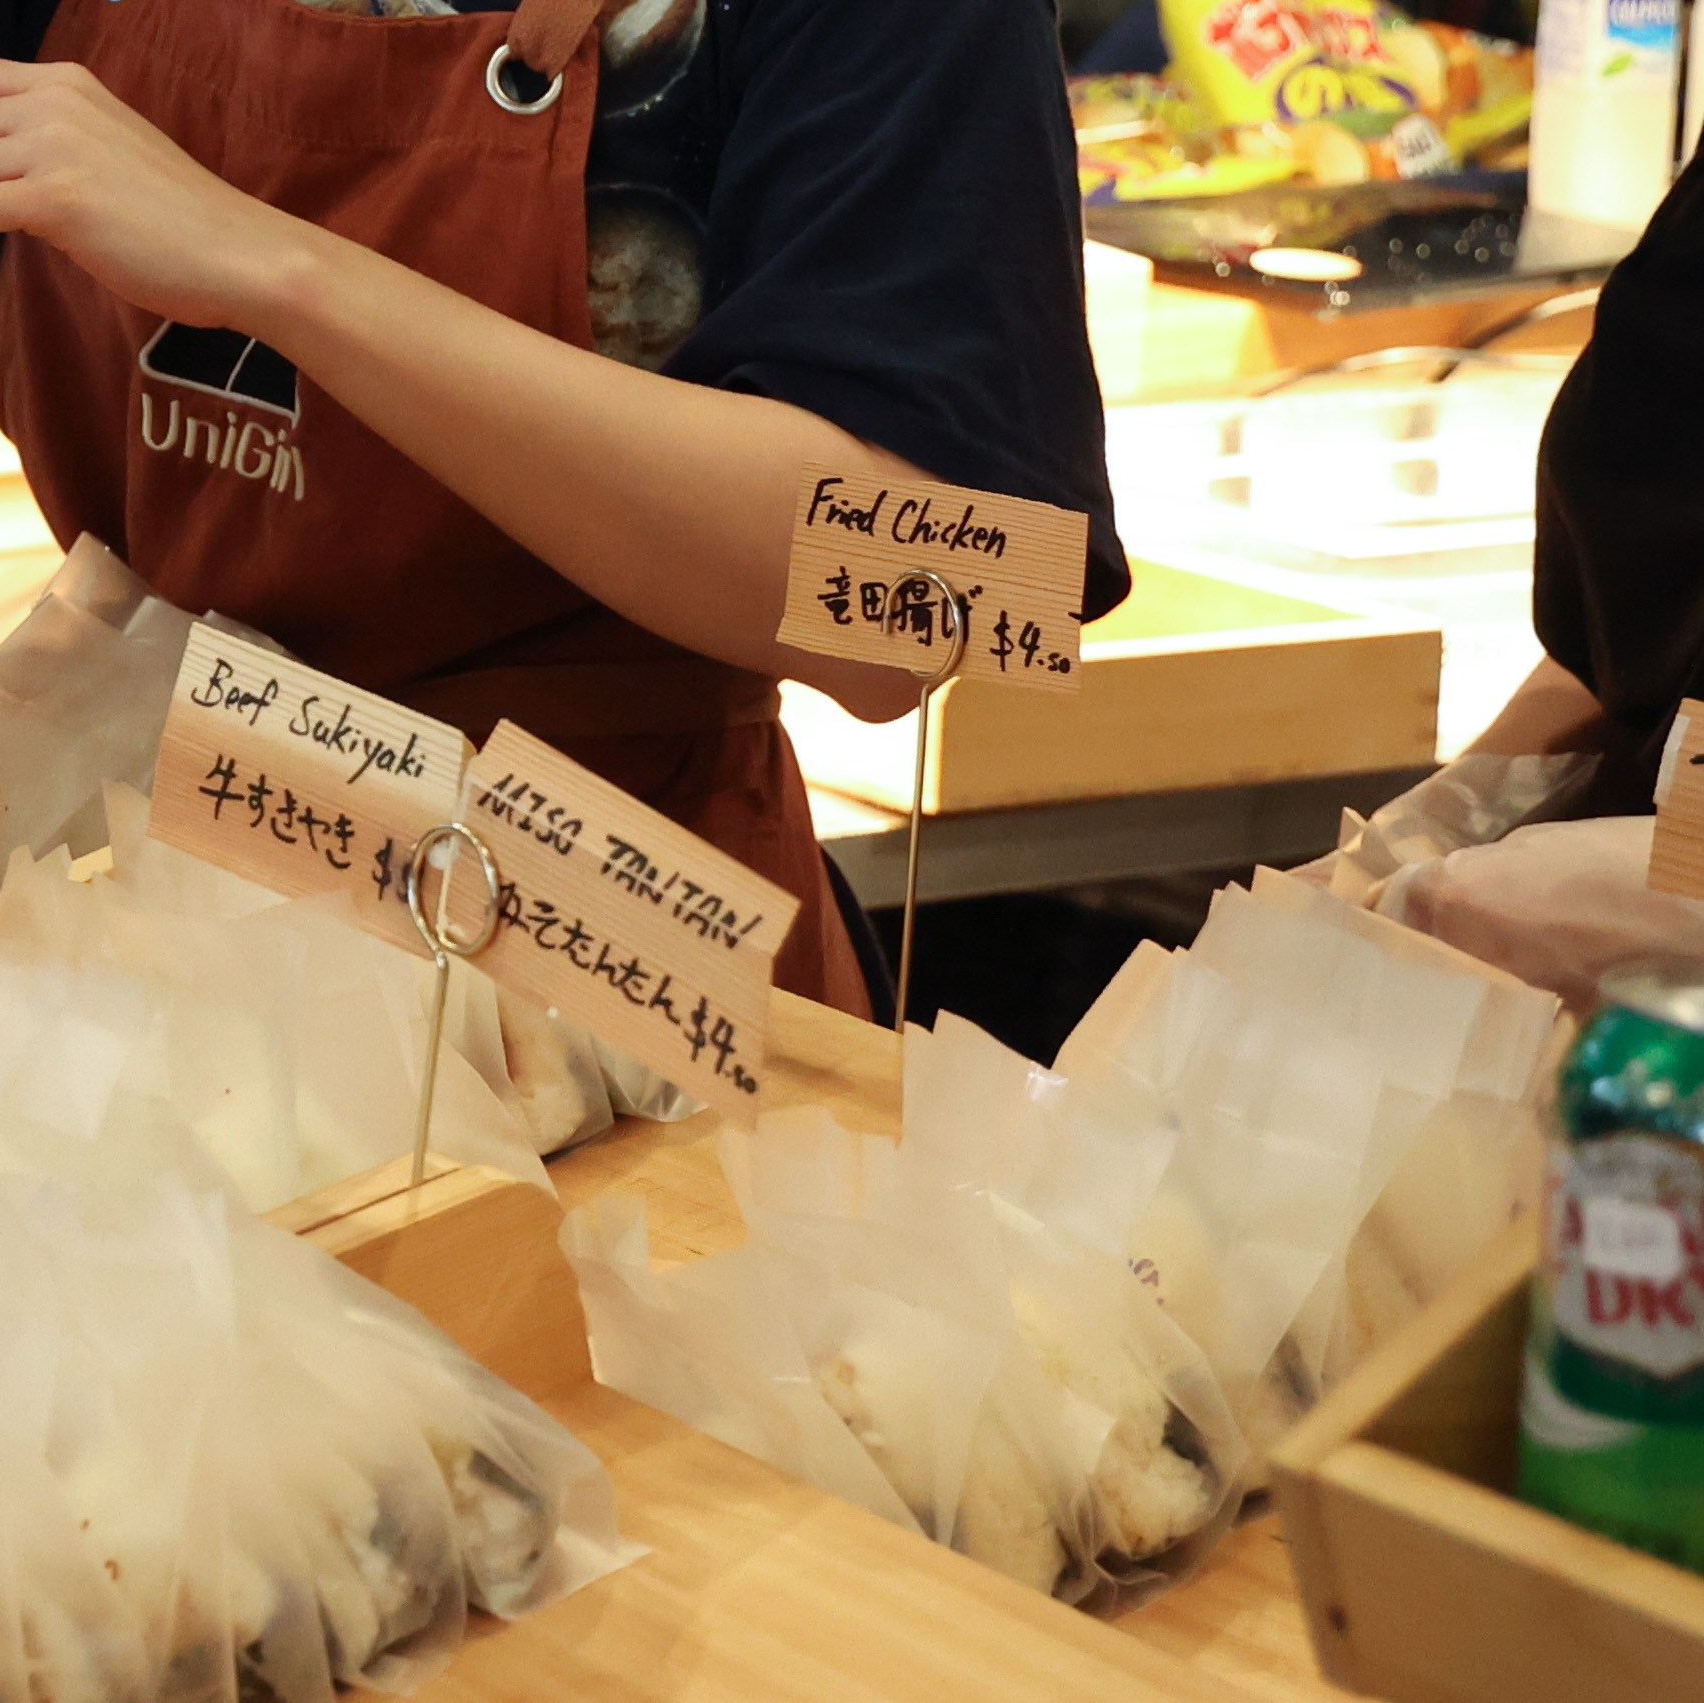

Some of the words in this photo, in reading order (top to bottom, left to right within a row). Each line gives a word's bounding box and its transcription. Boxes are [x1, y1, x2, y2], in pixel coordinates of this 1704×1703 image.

[805, 477, 888, 537] Fried
[891, 497, 1007, 559] Chicken
[989, 609, 1072, 672] $4.50
[190, 657, 280, 727] Beef
[289, 695, 428, 785] Sukiyaki
[197, 753, 356, 870] 牛すきやき
